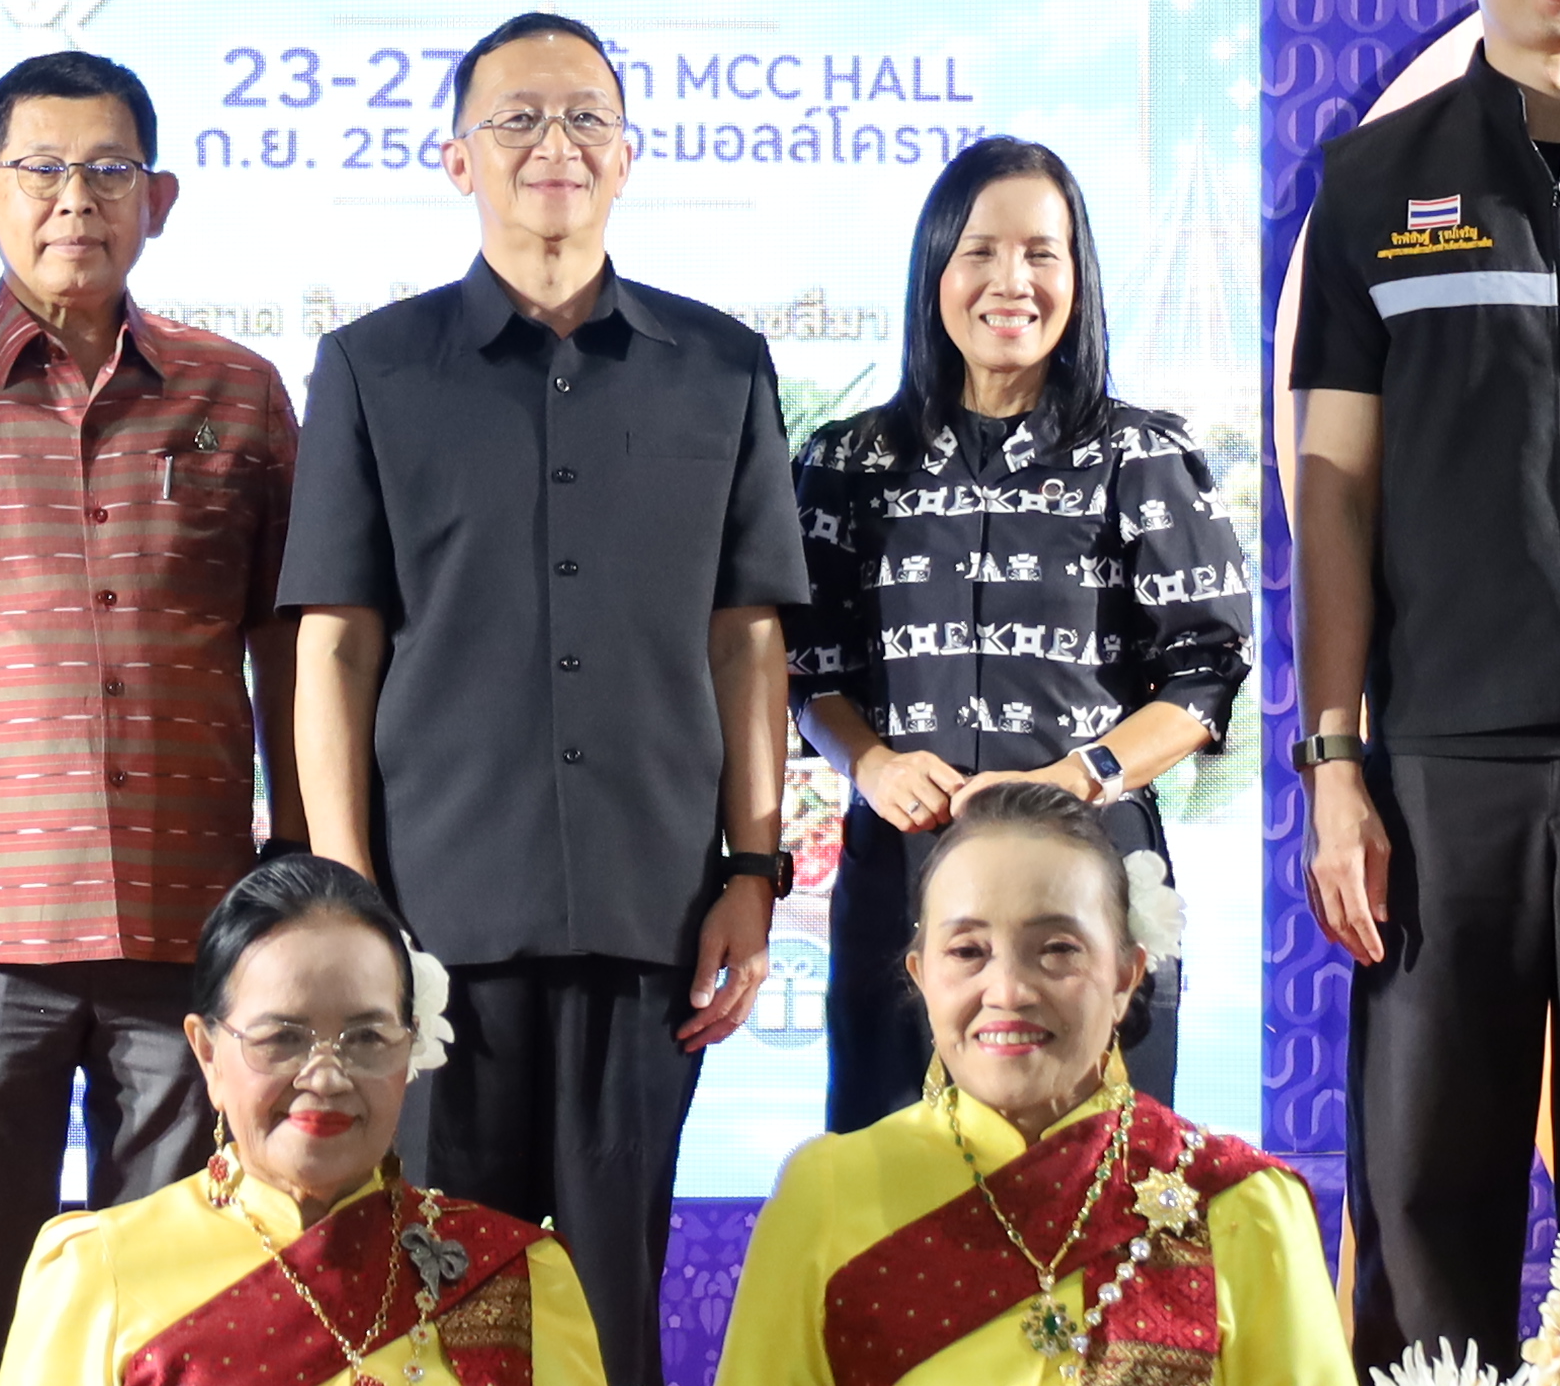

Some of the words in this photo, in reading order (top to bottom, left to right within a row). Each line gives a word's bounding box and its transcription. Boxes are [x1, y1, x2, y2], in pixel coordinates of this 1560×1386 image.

[221, 46, 468, 110] 23-27
[678, 53, 801, 103] MCC
[823, 53, 975, 103] HALL
[195, 127, 317, 170] ก.ย.
[341, 124, 443, 170] 256
